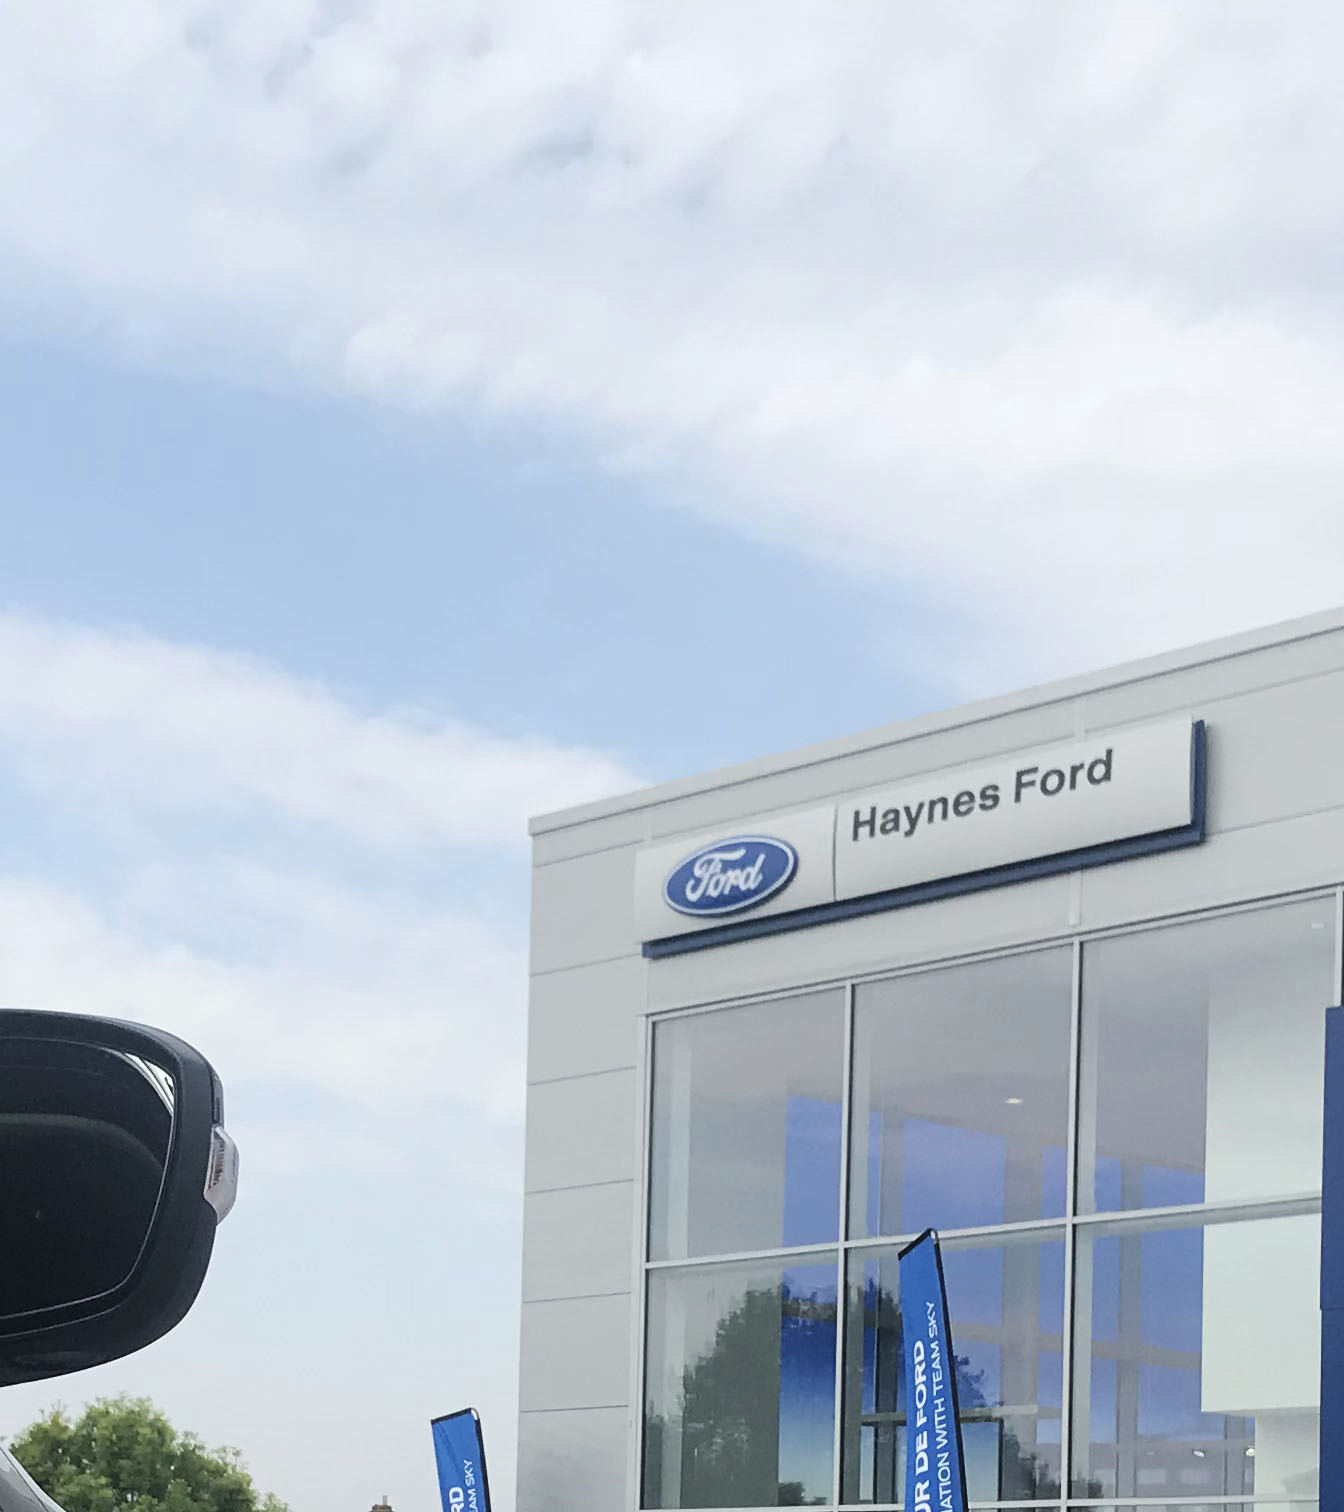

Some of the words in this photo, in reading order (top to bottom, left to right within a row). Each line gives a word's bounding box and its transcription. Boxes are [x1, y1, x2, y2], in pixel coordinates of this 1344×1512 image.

[852, 777, 1001, 842] Haynes
[1014, 748, 1113, 804] Ford
[685, 849, 763, 902] Ford
[926, 1301, 937, 1338] SKY
[914, 1340, 927, 1428] FORD
[931, 1341, 944, 1396] TEAM
[934, 1398, 946, 1450] WITH
[464, 1460, 475, 1486] SKY
[915, 1431, 929, 1475] DE
